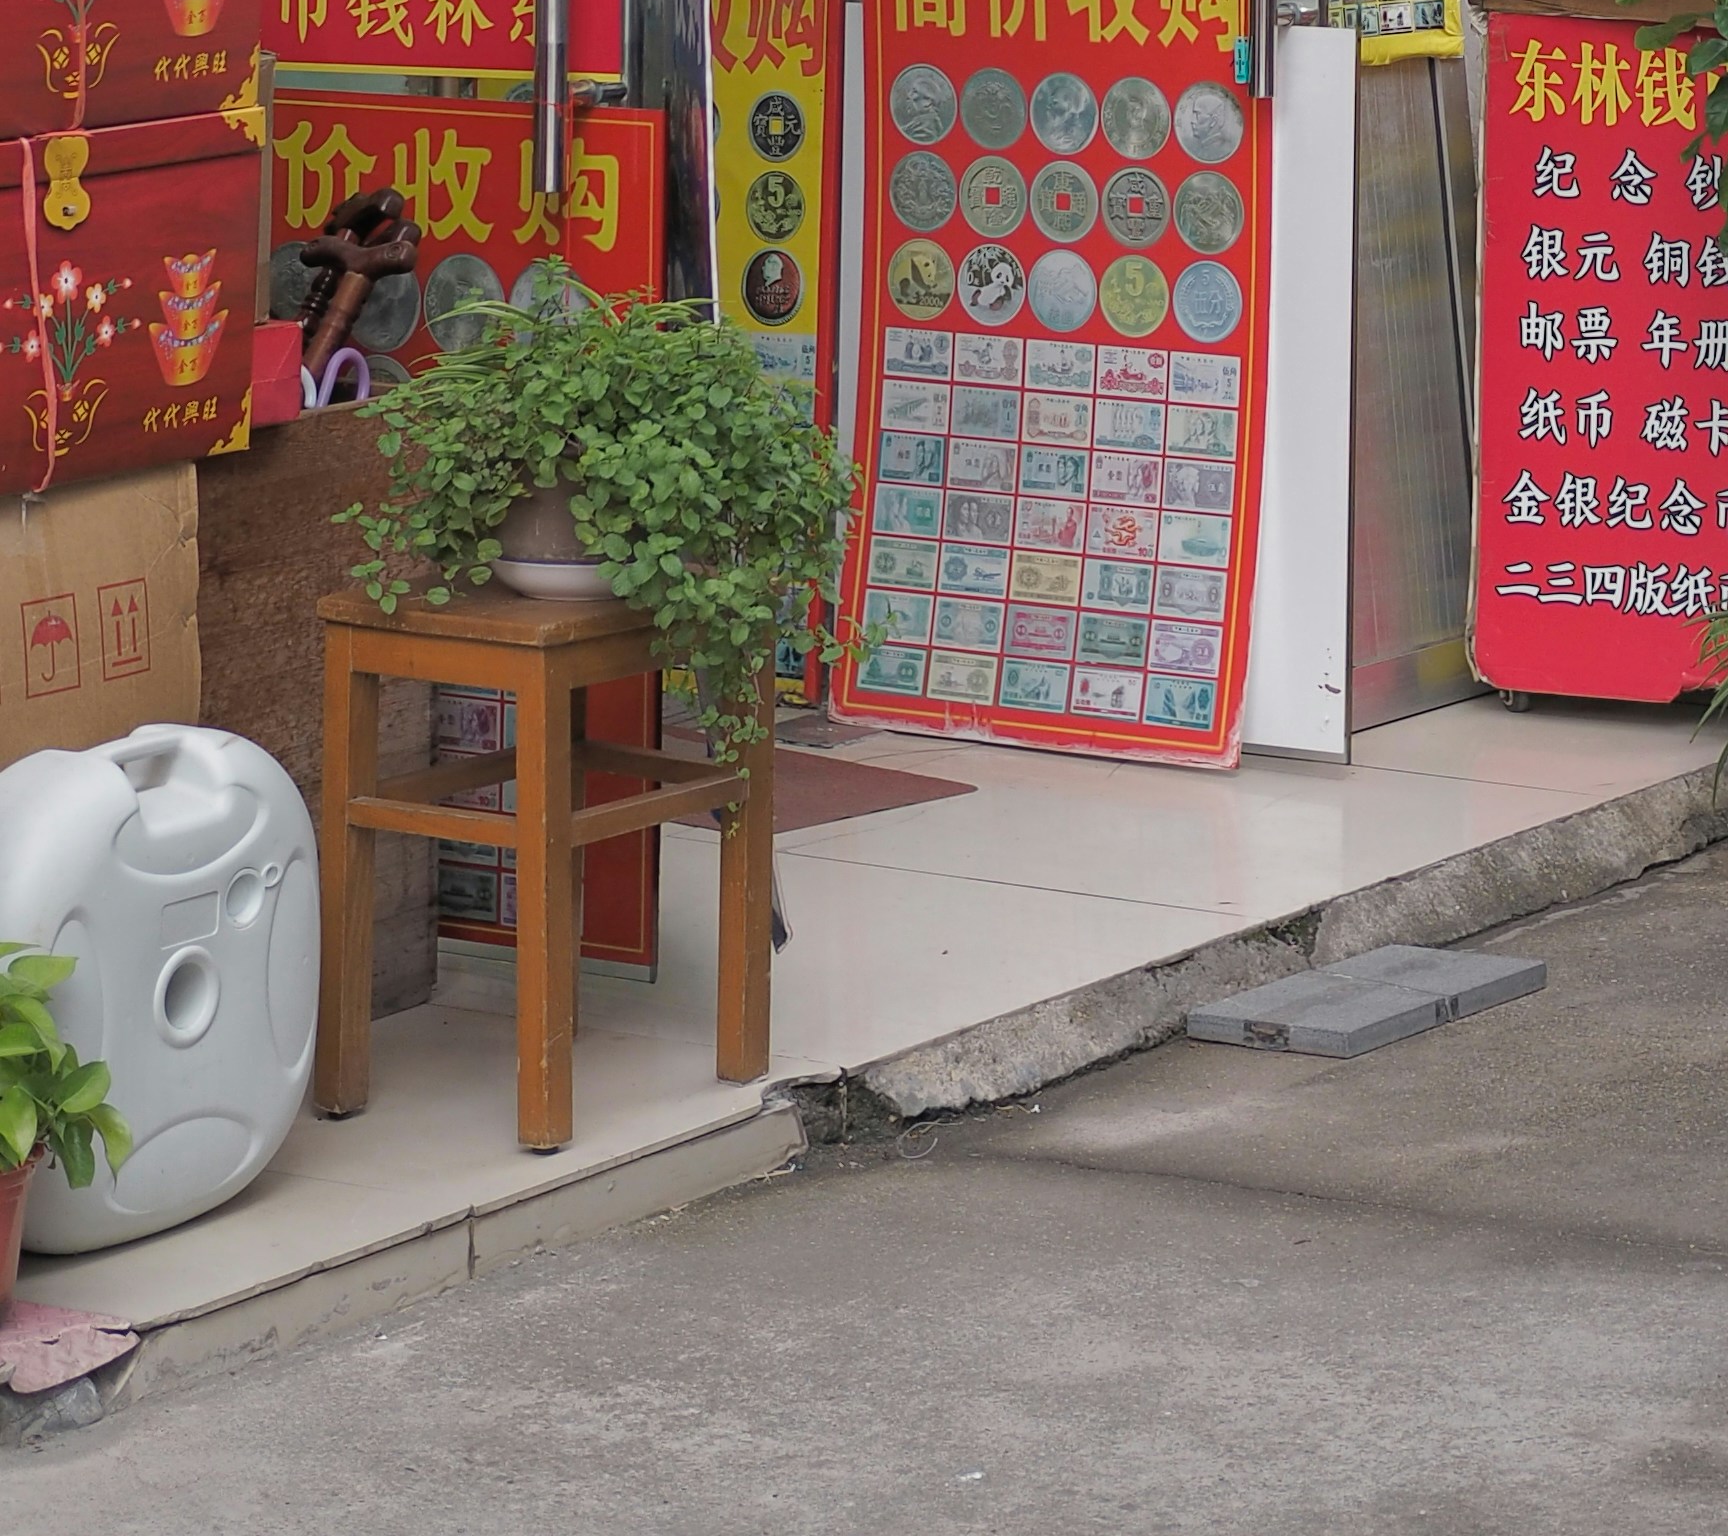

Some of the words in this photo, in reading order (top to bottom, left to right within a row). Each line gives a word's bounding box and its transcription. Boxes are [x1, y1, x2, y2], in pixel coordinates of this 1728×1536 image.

[1521, 224, 1620, 281] 银元
[1520, 300, 1618, 364] 邮票
[1518, 386, 1614, 449] 纸币
